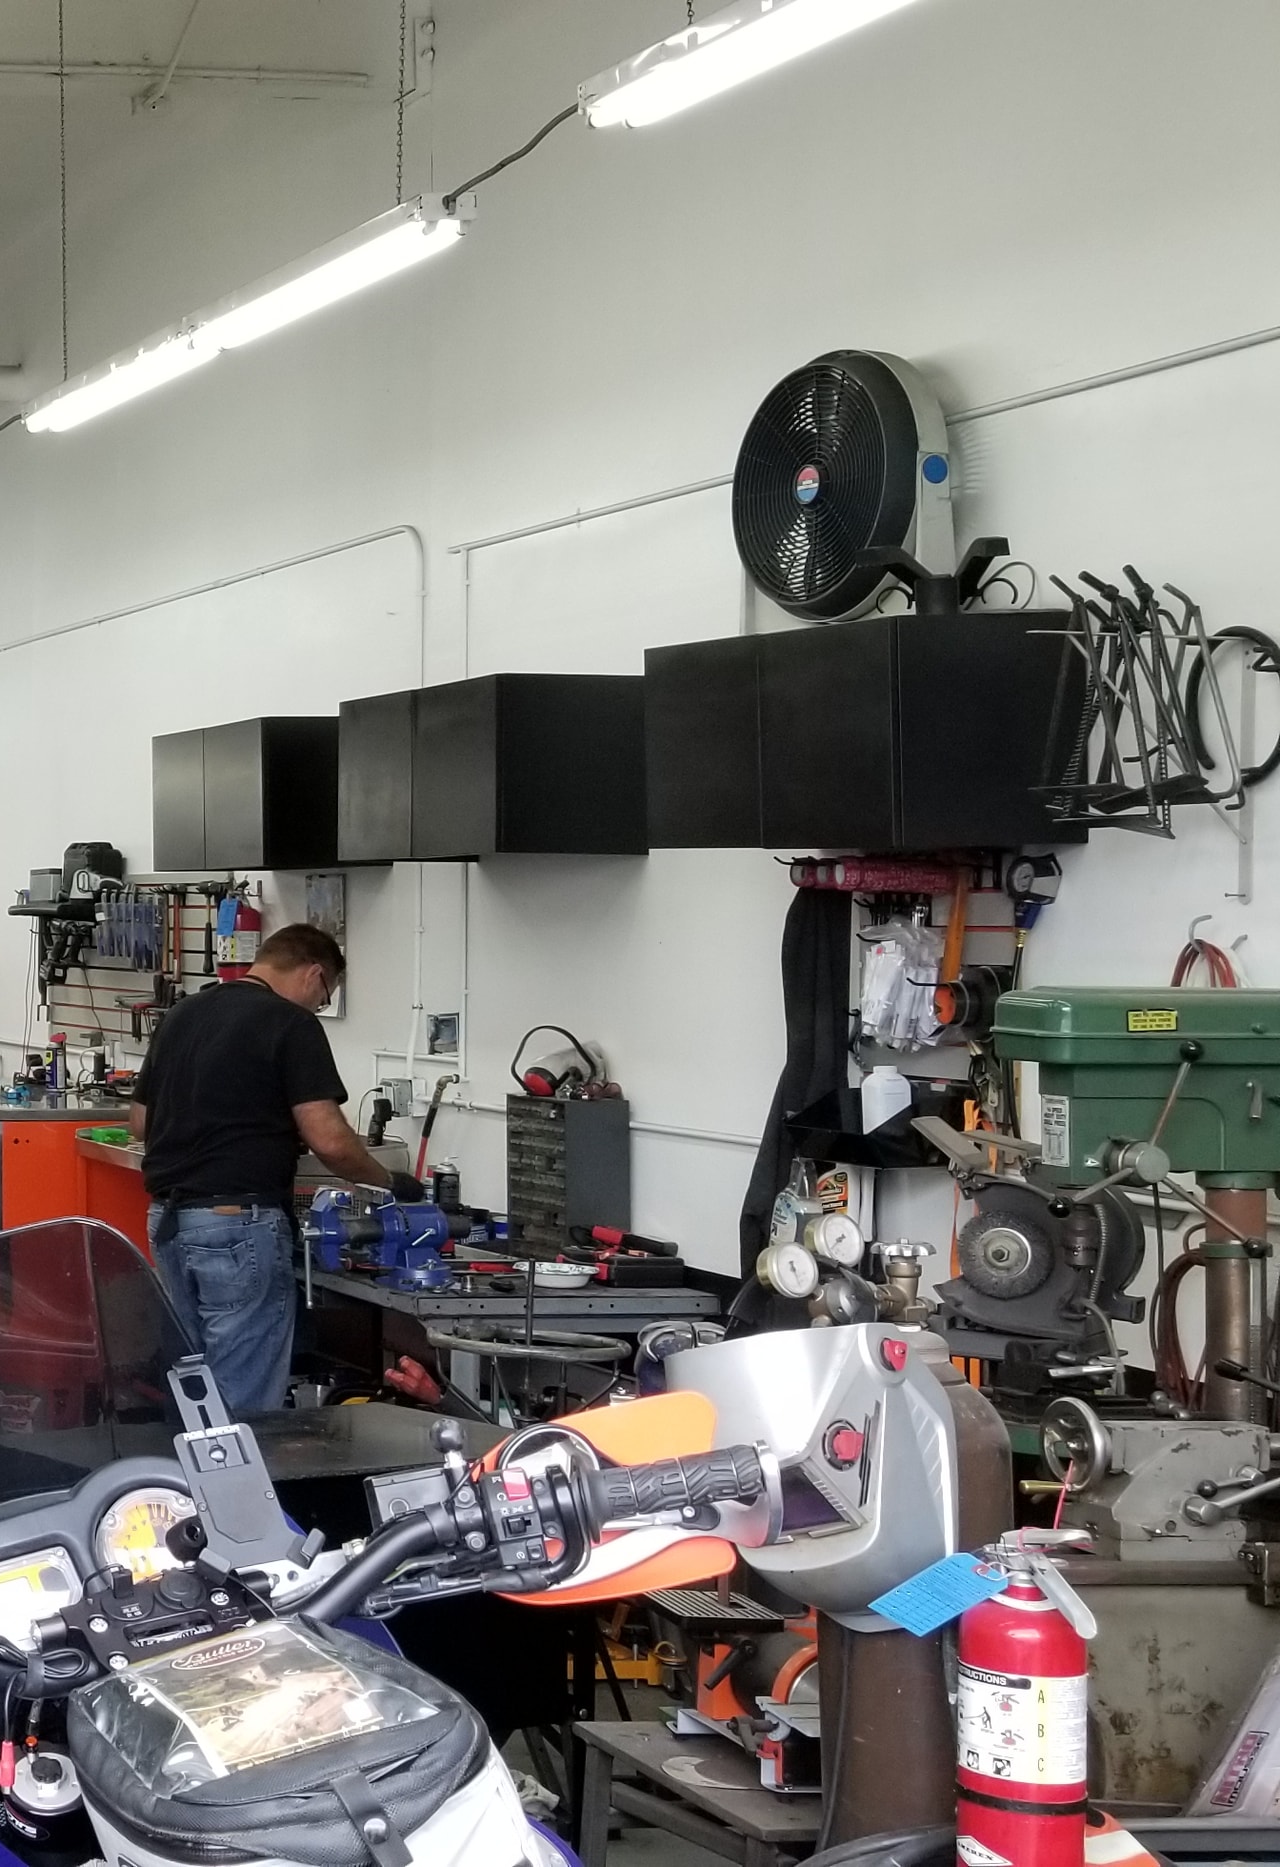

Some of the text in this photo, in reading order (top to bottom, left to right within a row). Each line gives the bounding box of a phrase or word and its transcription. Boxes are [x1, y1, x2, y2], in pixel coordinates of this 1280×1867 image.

[1037, 1690, 1045, 1704] A
[1037, 1723, 1045, 1738] B
[1037, 1757, 1045, 1773] C
